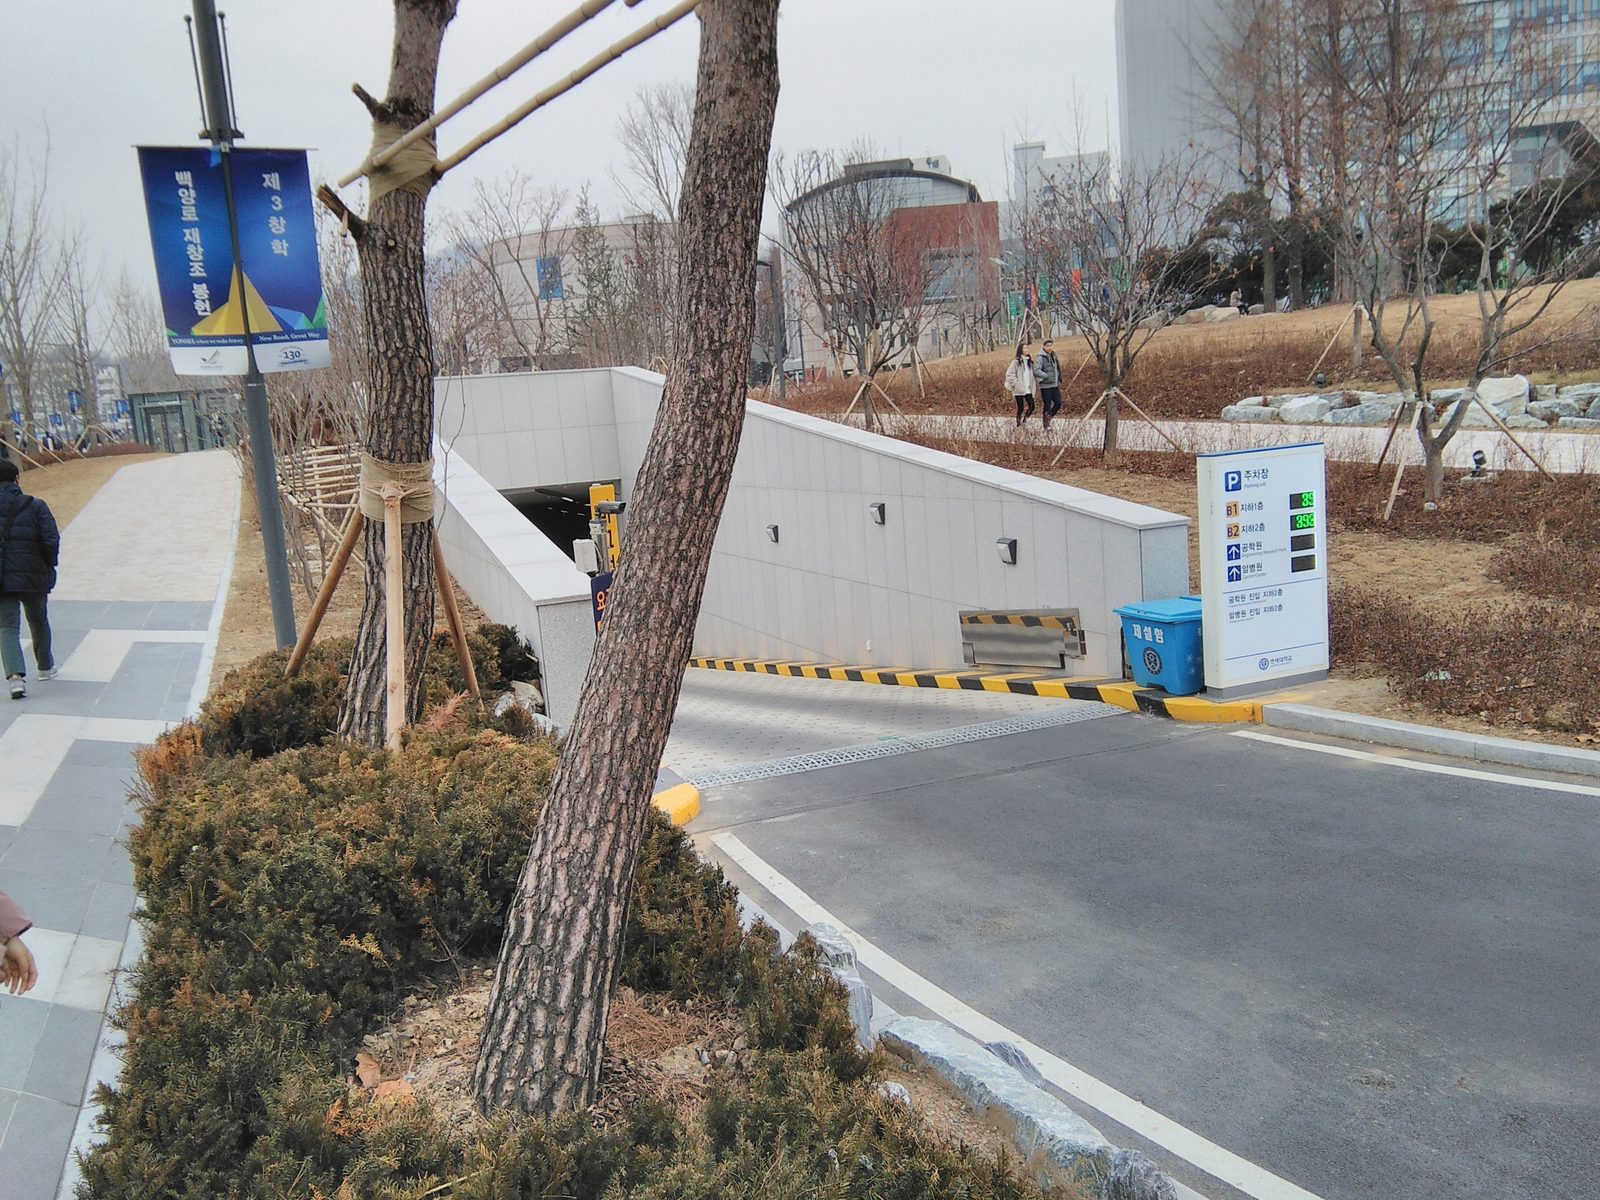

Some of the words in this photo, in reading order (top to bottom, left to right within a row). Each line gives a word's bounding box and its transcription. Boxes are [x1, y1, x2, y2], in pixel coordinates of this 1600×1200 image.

[175, 171, 199, 221] 백양로
[183, 227, 207, 277] 재창조
[192, 283, 212, 316] 봉헌
[308, 332, 320, 340] Way
[283, 350, 301, 360] 130
[1244, 468, 1269, 480] 주차장
[1228, 473, 1239, 490] P
[1226, 504, 1238, 516] B1
[1240, 501, 1264, 512] 지하1층
[1227, 525, 1239, 538] B2
[1241, 522, 1265, 533] 지하2층
[1242, 541, 1262, 552] 공학원
[1242, 562, 1263, 574] 암병원
